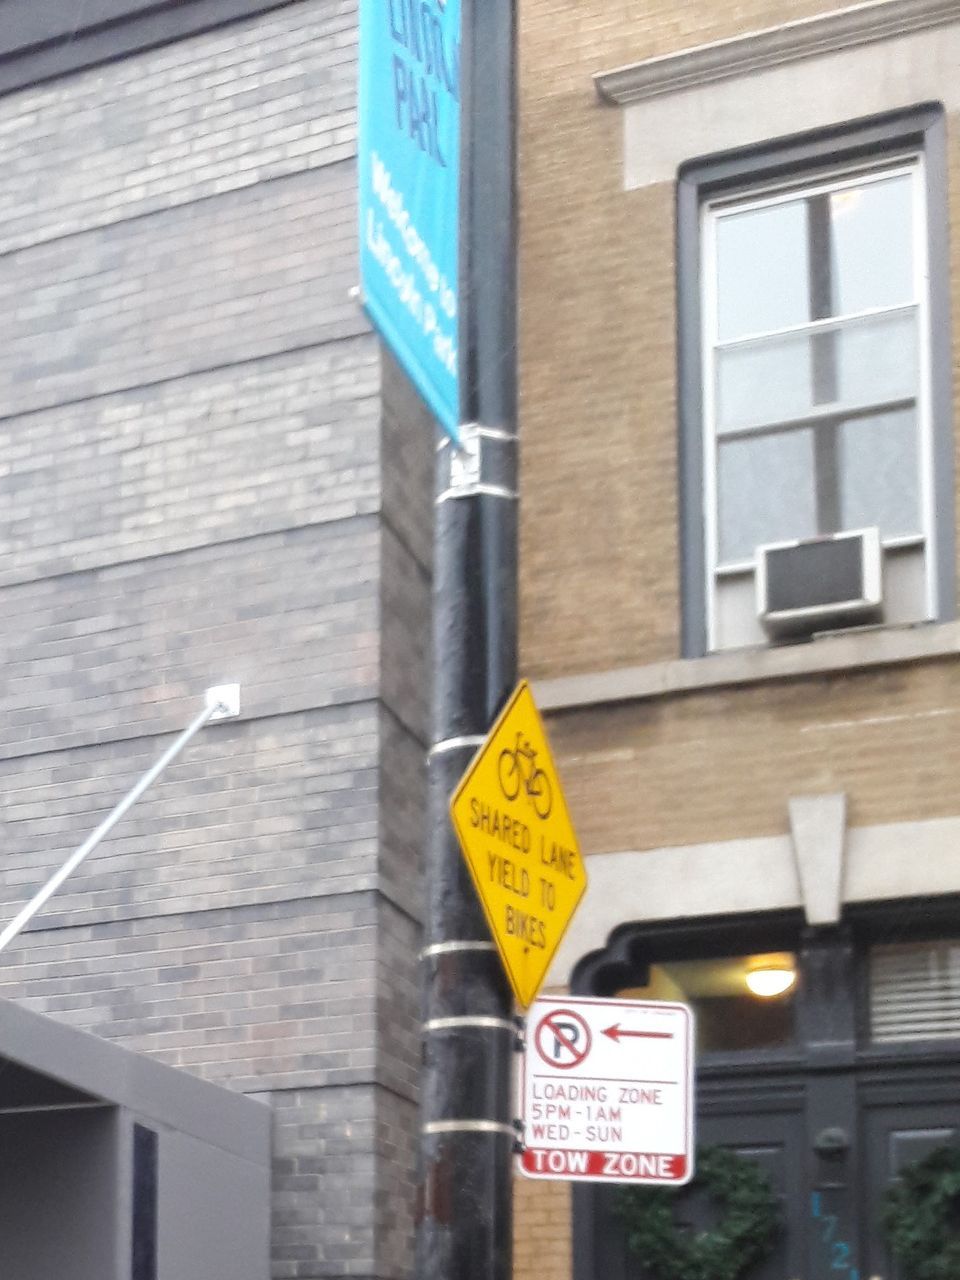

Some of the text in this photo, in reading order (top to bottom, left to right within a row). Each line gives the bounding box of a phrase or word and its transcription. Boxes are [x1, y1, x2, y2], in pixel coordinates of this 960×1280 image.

[470, 797, 576, 882] SHARED LANE
[488, 850, 556, 912] YIELD TO
[506, 903, 546, 949] BIKES
[532, 1082, 664, 1106] LOADING ZONE
[532, 1150, 676, 1178] TOW ZONE
